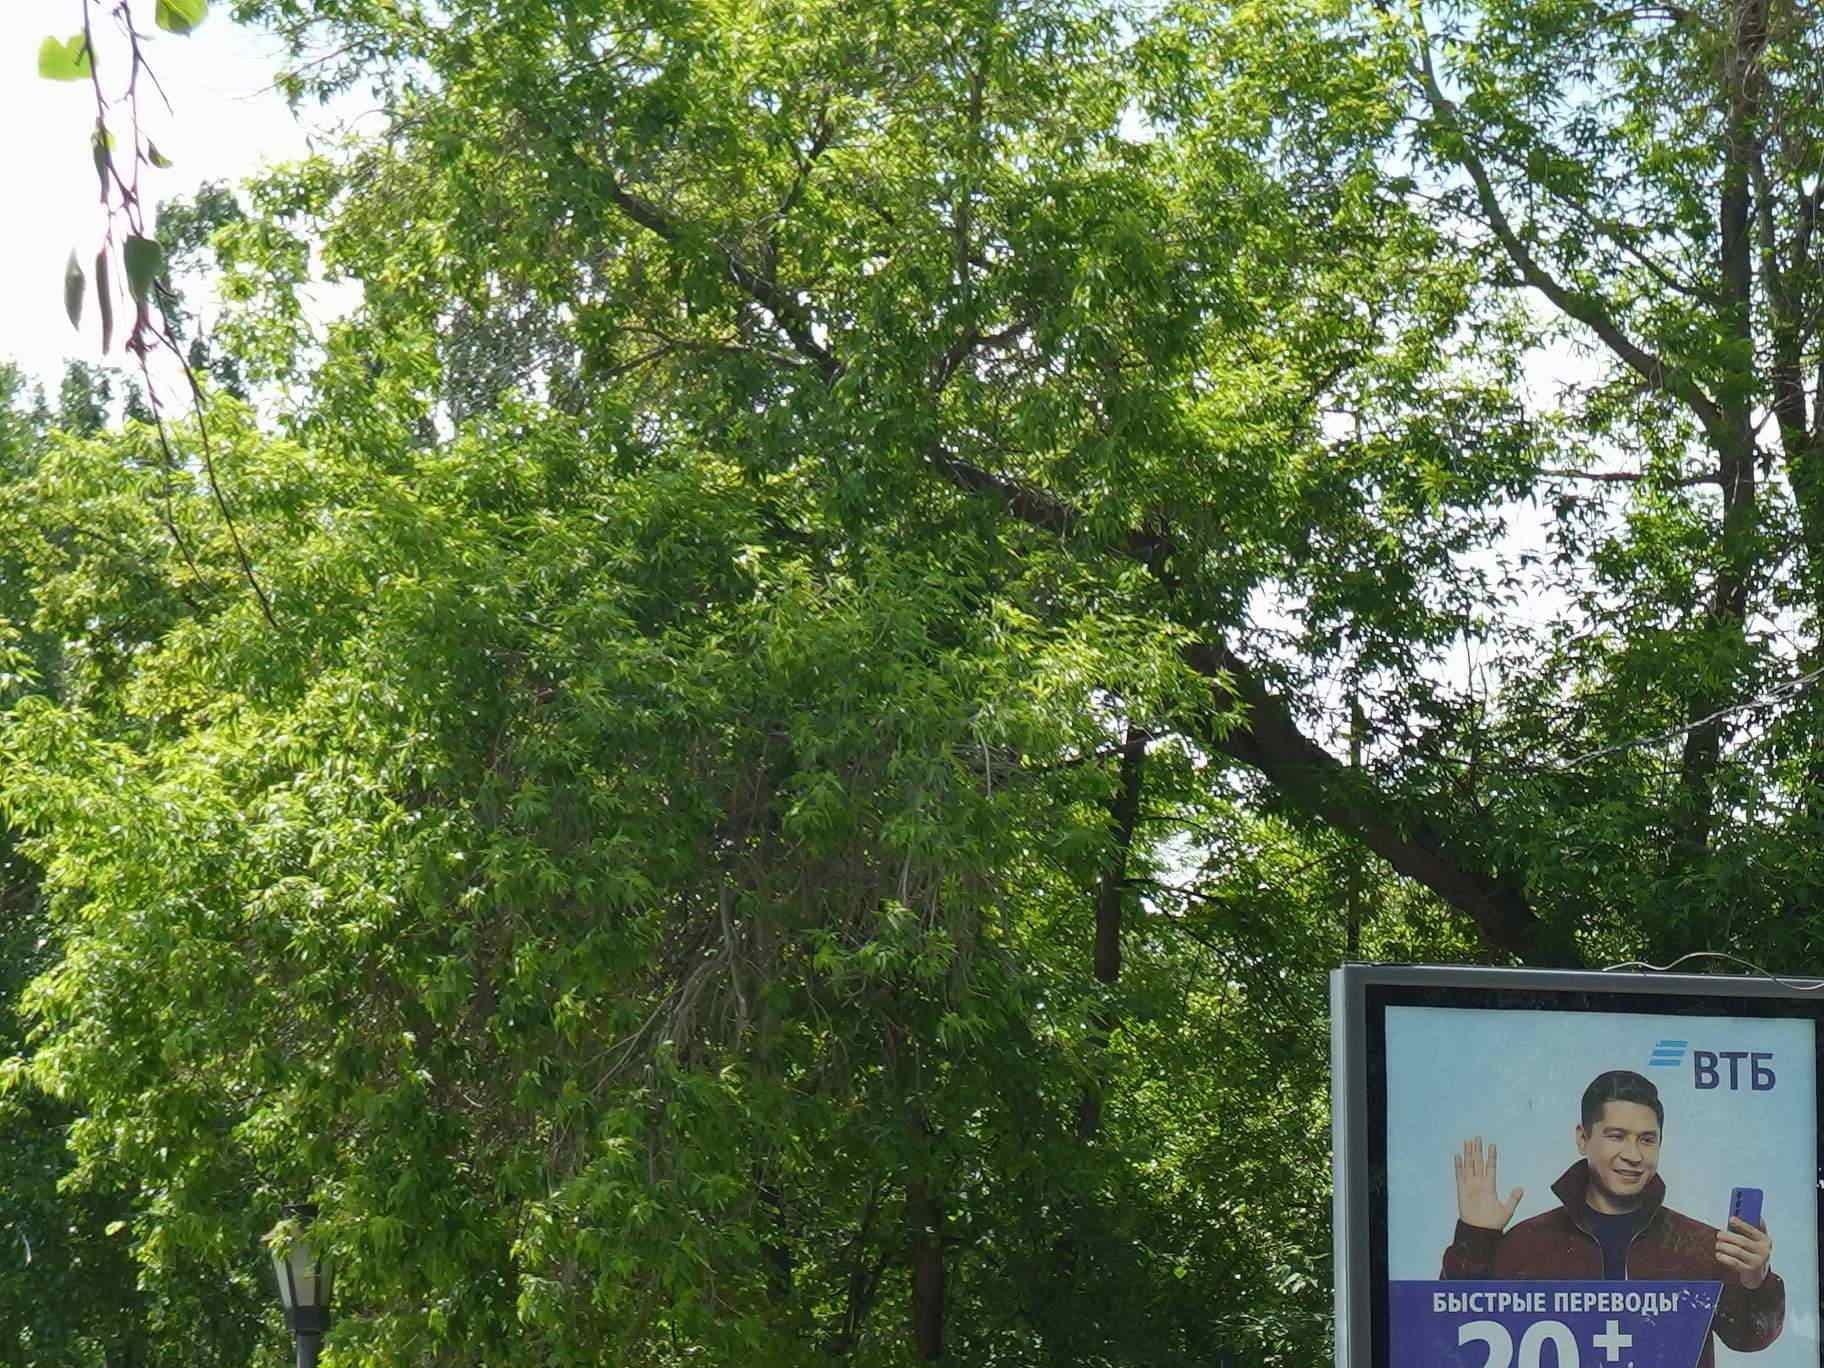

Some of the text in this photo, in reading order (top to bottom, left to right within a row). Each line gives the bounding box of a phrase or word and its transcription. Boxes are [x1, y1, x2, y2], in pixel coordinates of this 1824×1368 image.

[1694, 1051, 1777, 1092] ВТБ
[1433, 1290, 1679, 1315] БЫСТРЫЕ ПЕРЕВОДЫ
